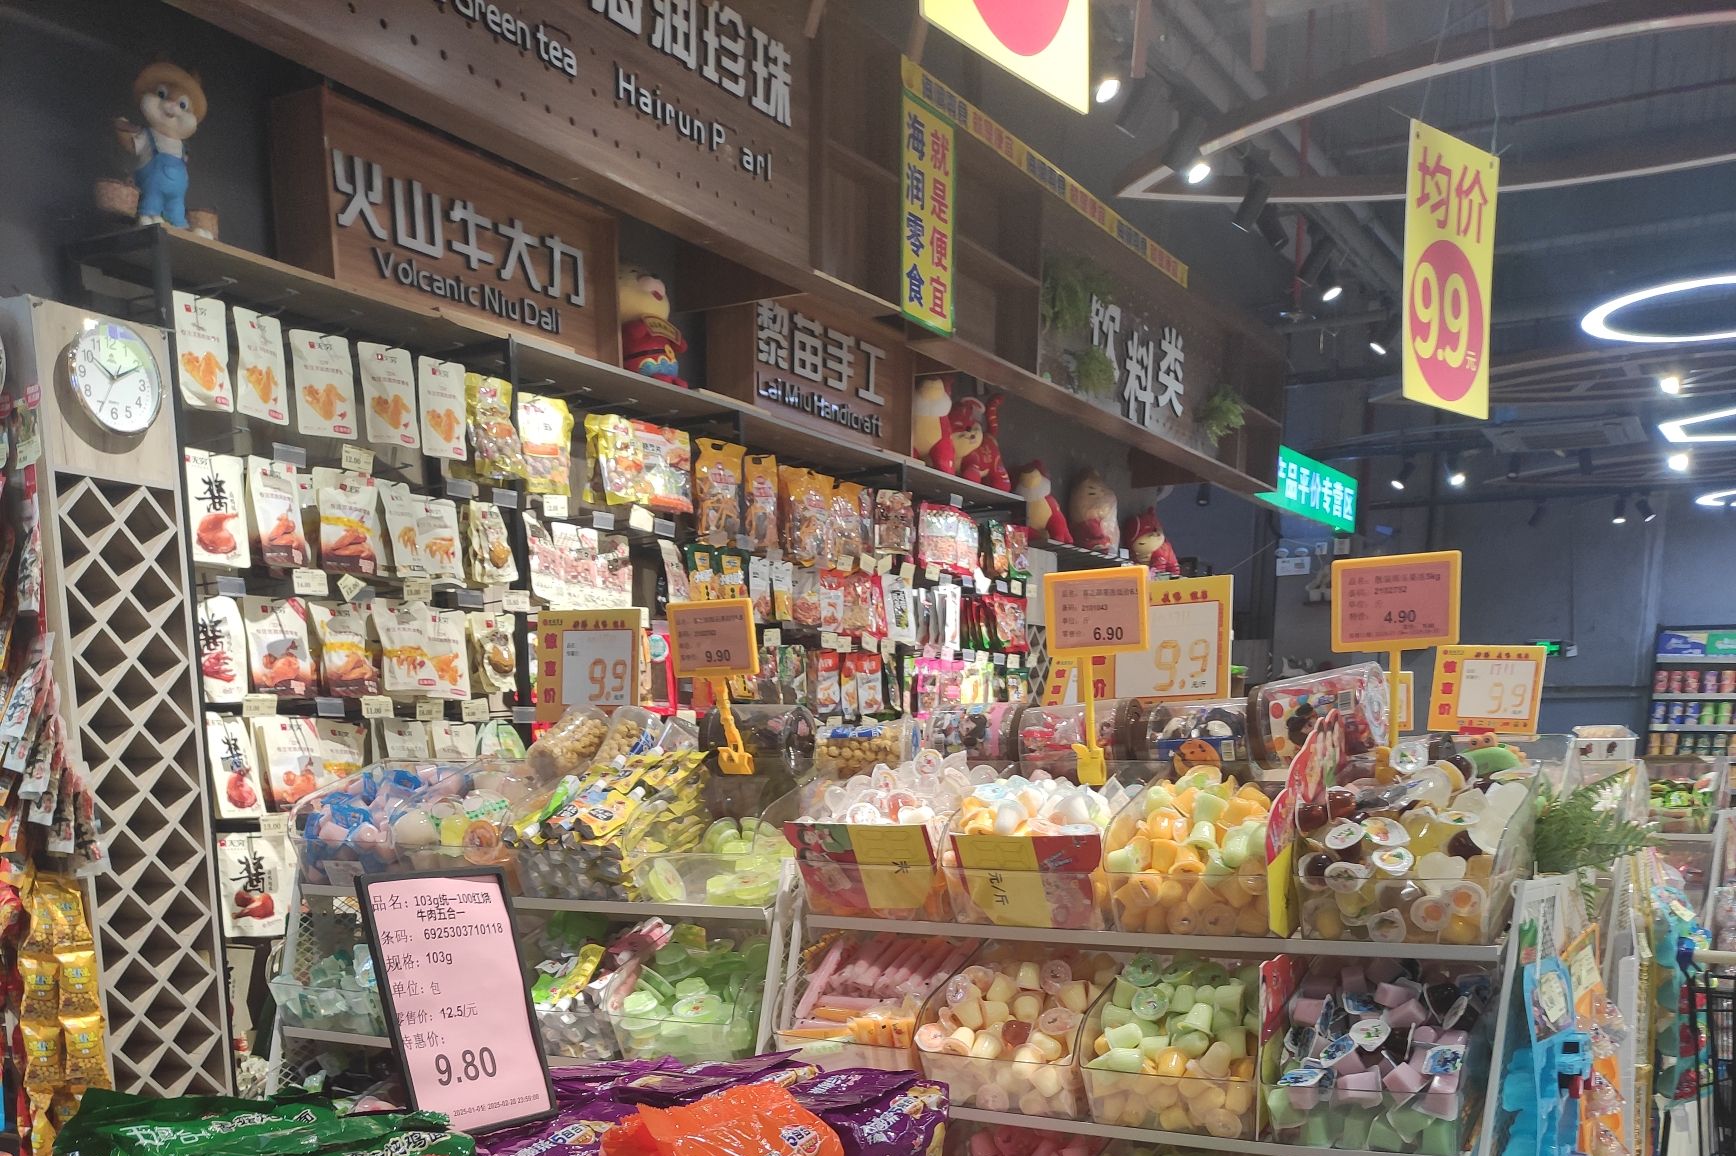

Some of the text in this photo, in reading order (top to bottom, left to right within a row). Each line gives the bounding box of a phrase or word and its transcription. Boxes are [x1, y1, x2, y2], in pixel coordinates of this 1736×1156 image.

[536, 25, 577, 77] tea
[616, 67, 705, 145] Hairun
[1416, 145, 1489, 243] 均价
[906, 110, 925, 307] 海润零食
[333, 149, 586, 307] 火山牛大力
[930, 128, 950, 320] 就是便宜
[374, 247, 561, 334] Volcanic Niu Dali
[1410, 262, 1470, 368] 9.9
[757, 300, 886, 406] 黎苗手工
[78, 365, 86, 377] 9
[84, 384, 92, 397] 8
[139, 379, 146, 392] 3
[125, 406, 133, 419] 5
[135, 396, 142, 408] 4
[111, 407, 119, 420] 6
[814, 392, 882, 437] Handicraft
[1383, 609, 1417, 624] 4.90
[1093, 626, 1124, 641] 6.90
[705, 649, 731, 662] 9.90
[372, 893, 409, 912] 品名：
[381, 922, 504, 945] 条码： 6925303710118
[386, 951, 453, 972] 规格： 103g
[392, 979, 441, 998] 单位： 包
[434, 1046, 497, 1086] 9.80
